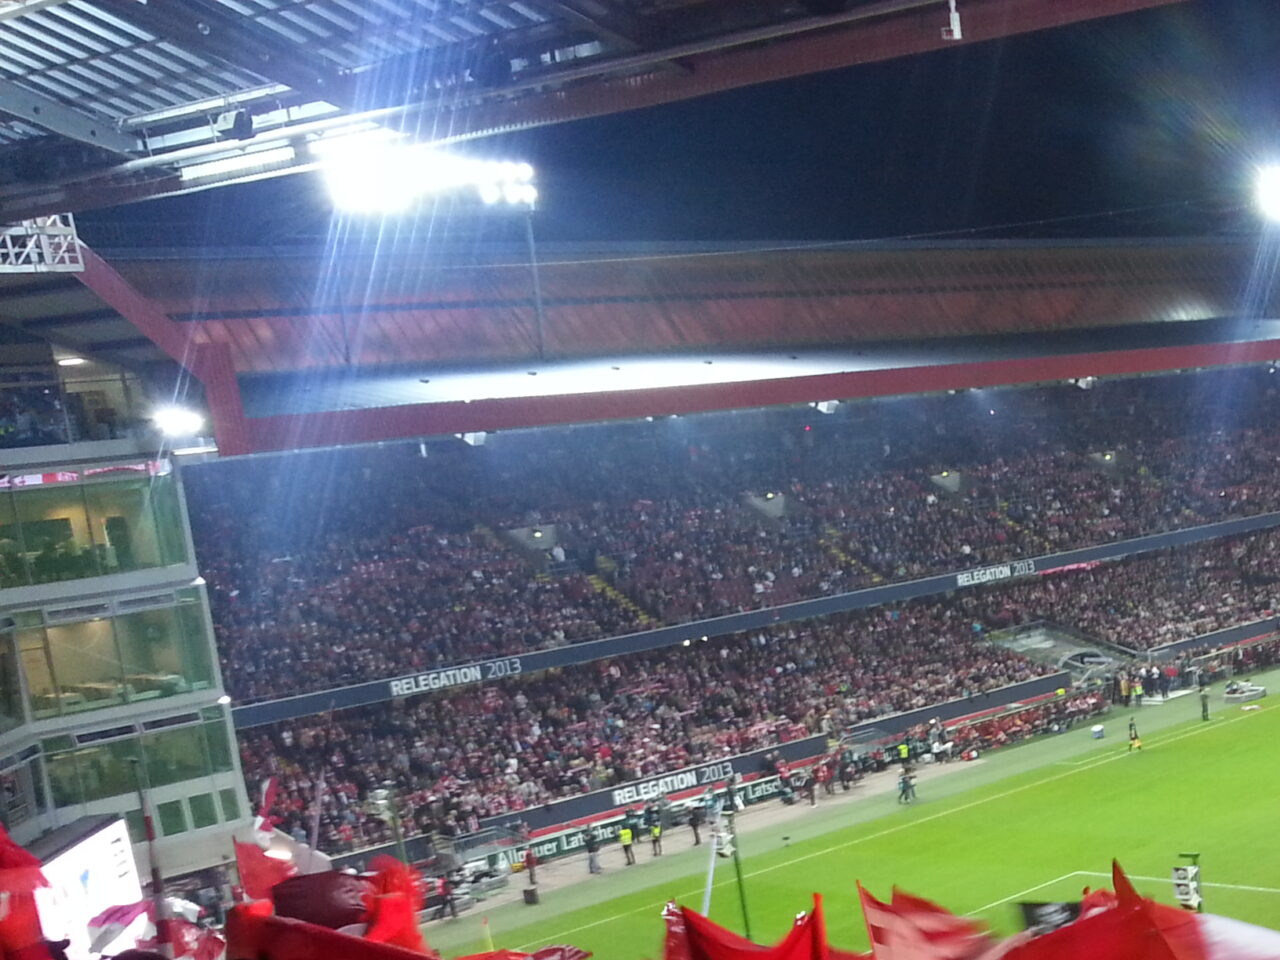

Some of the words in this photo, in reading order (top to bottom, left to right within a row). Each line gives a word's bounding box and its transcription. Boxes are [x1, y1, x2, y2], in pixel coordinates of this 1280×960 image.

[957, 565, 1012, 586] RELEGATION
[1013, 560, 1036, 576] 2013
[390, 666, 482, 696] RELEGATION
[485, 658, 522, 678] 2013
[613, 771, 698, 806] RELEGATION
[700, 762, 733, 783] 2013
